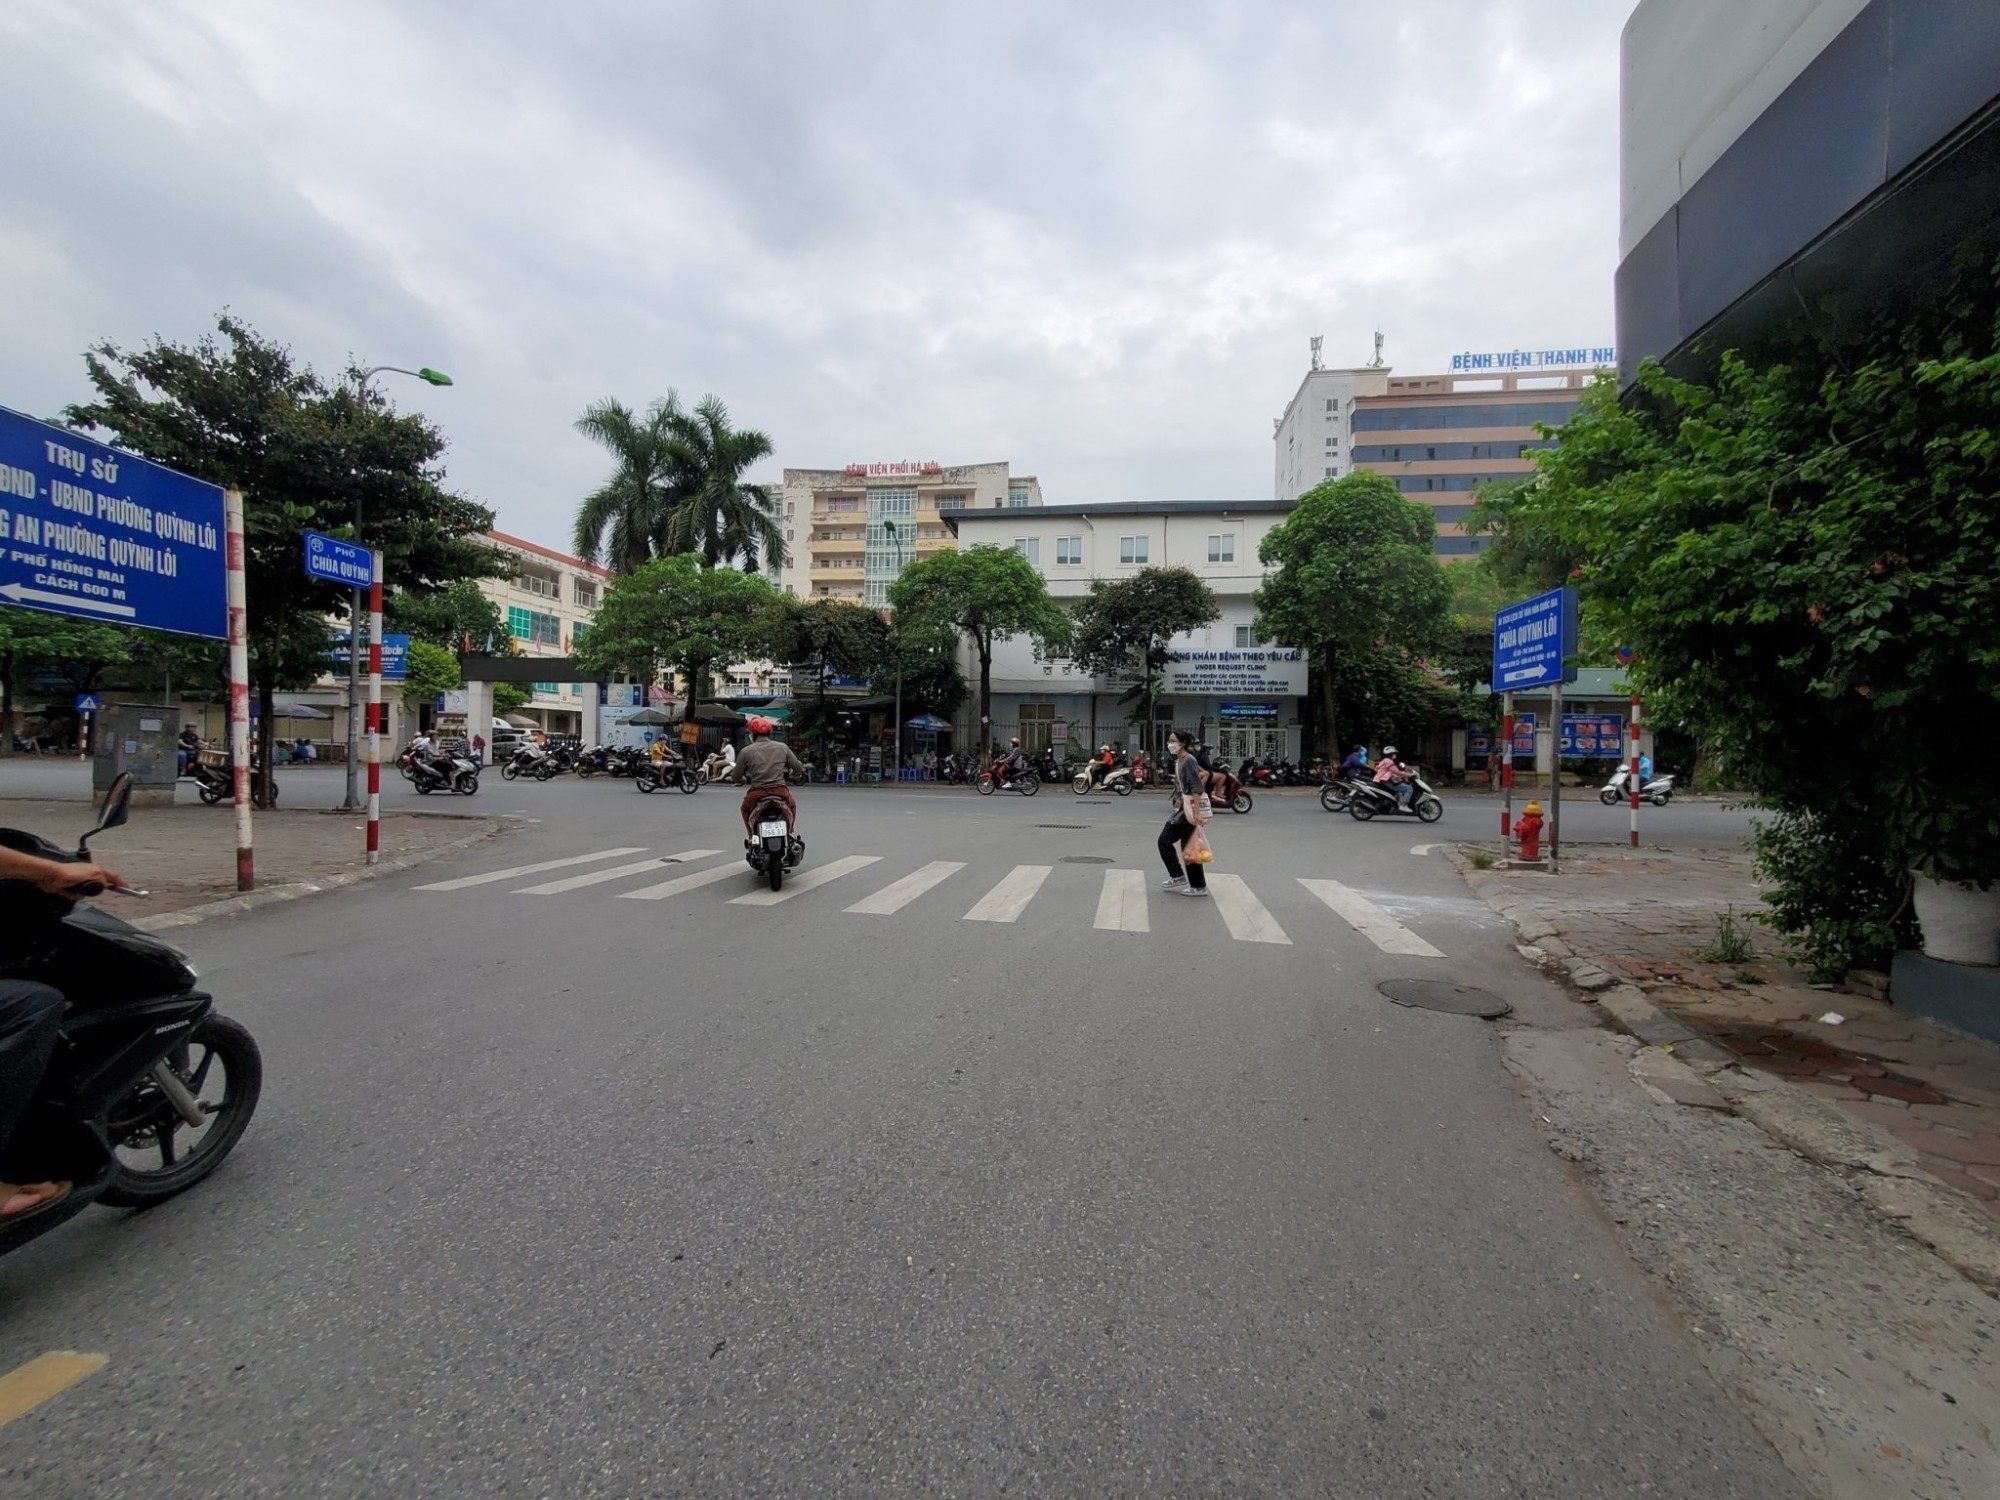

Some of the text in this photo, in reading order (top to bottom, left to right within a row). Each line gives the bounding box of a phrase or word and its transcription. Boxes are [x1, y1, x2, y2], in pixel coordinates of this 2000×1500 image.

[44, 440, 119, 485] TRỤ SỞ
[51, 479, 93, 517] UBND
[97, 495, 152, 534] PHƯỜNG
[156, 512, 196, 545] QUỲNH
[198, 521, 217, 552] LÔI
[14, 513, 39, 545] AN
[44, 521, 106, 562] PHƯỜNG
[109, 537, 154, 572] QUỲNH
[157, 547, 177, 578] LÔI
[11, 550, 47, 567] PHỐ
[97, 569, 125, 584] MAI
[35, 573, 126, 600] CÁCH 600 M
[155, 1019, 190, 1035] HONDA
